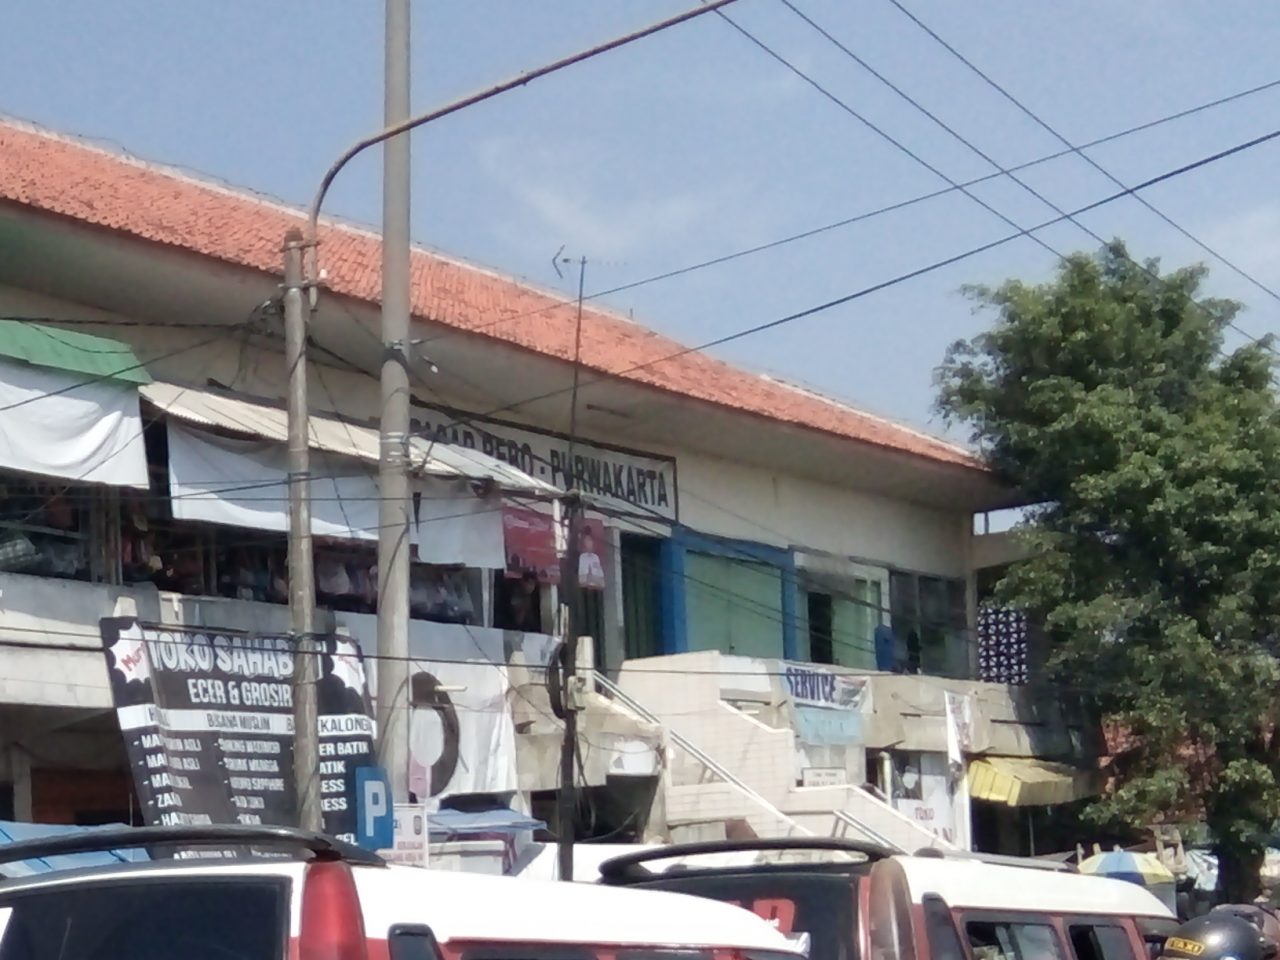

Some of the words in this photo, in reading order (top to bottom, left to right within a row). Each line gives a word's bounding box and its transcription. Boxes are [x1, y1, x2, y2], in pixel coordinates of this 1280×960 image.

[549, 449, 669, 508] PURWAKARTA
[142, 629, 213, 673] TOKO
[187, 678, 226, 704] ECER
[228, 681, 240, 705] &
[241, 682, 294, 708] GROSIR
[786, 666, 837, 703] SERVICE
[337, 741, 369, 755] BATIK
[364, 781, 387, 837] P
[1170, 939, 1202, 954] TAXI
